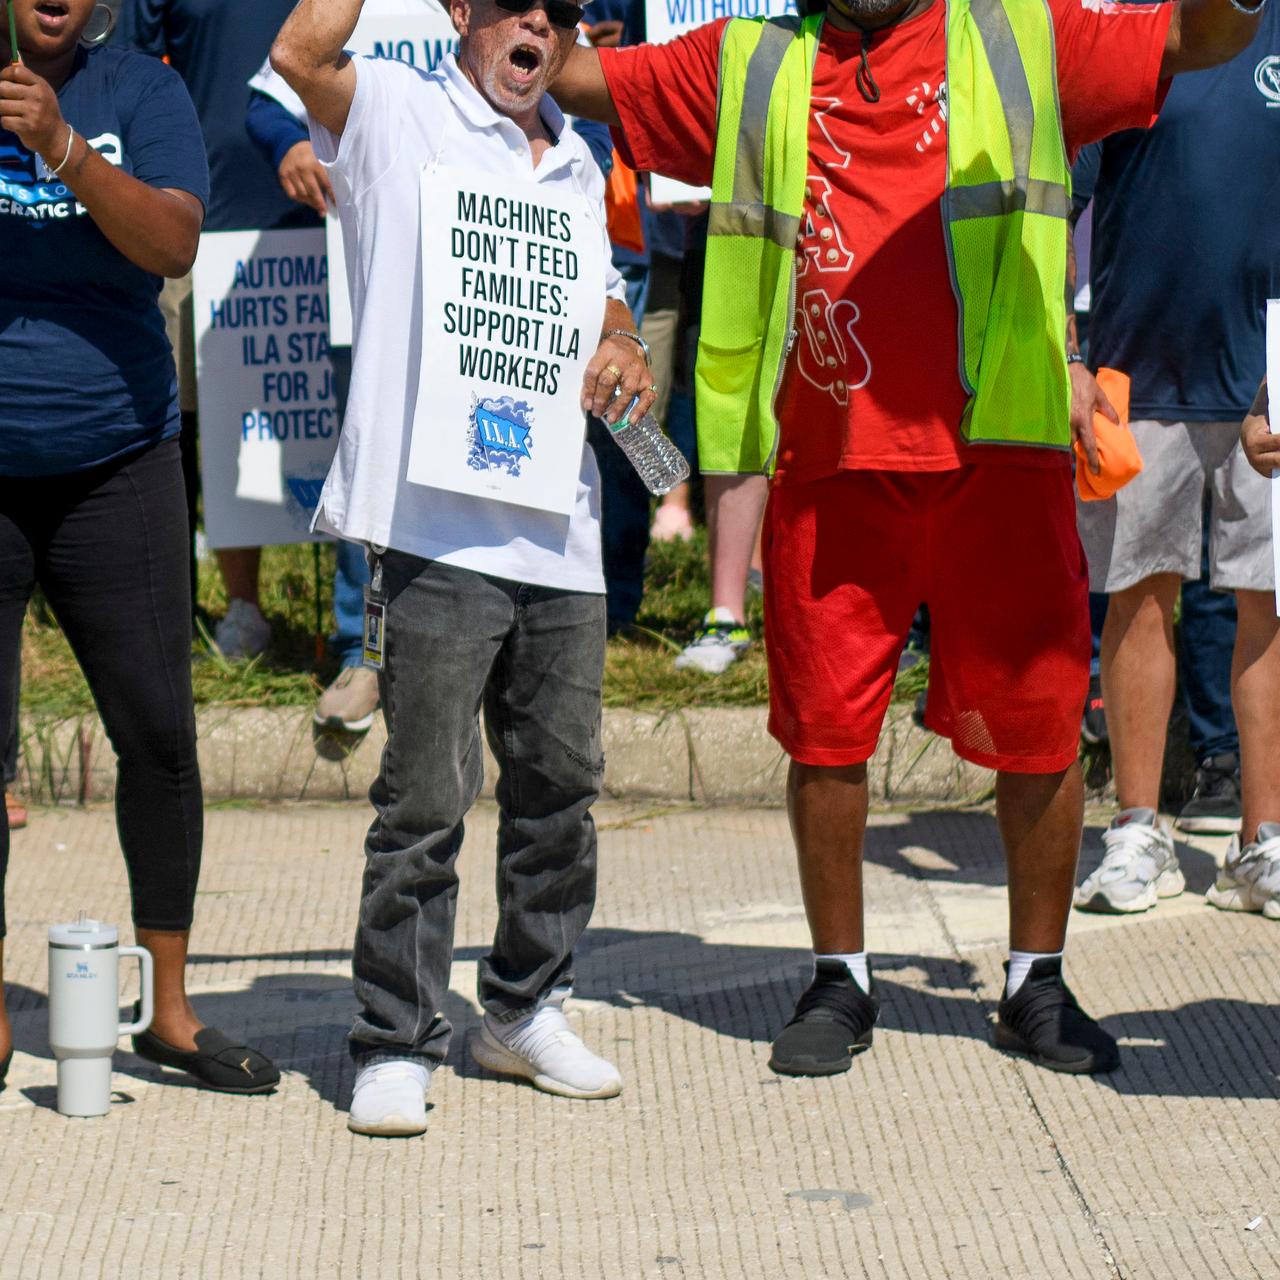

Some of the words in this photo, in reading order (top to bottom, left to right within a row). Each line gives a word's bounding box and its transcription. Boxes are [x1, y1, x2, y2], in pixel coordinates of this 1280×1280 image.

[38, 184, 69, 198] CO
[457, 190, 572, 242] MACHINES
[233, 256, 328, 289] AUTOMA
[451, 228, 518, 266] DON'T
[525, 241, 578, 281] FEED
[461, 267, 569, 318] FAMILIES:
[210, 295, 288, 329] HURTS
[296, 293, 330, 324] FA
[443, 301, 544, 352] SUPPORT
[549, 324, 580, 360] ILA
[243, 334, 280, 366] ILA
[288, 332, 331, 363] STA
[263, 371, 309, 402] FOR
[459, 343, 561, 395] WORKERS
[242, 408, 337, 441] PROTEC
